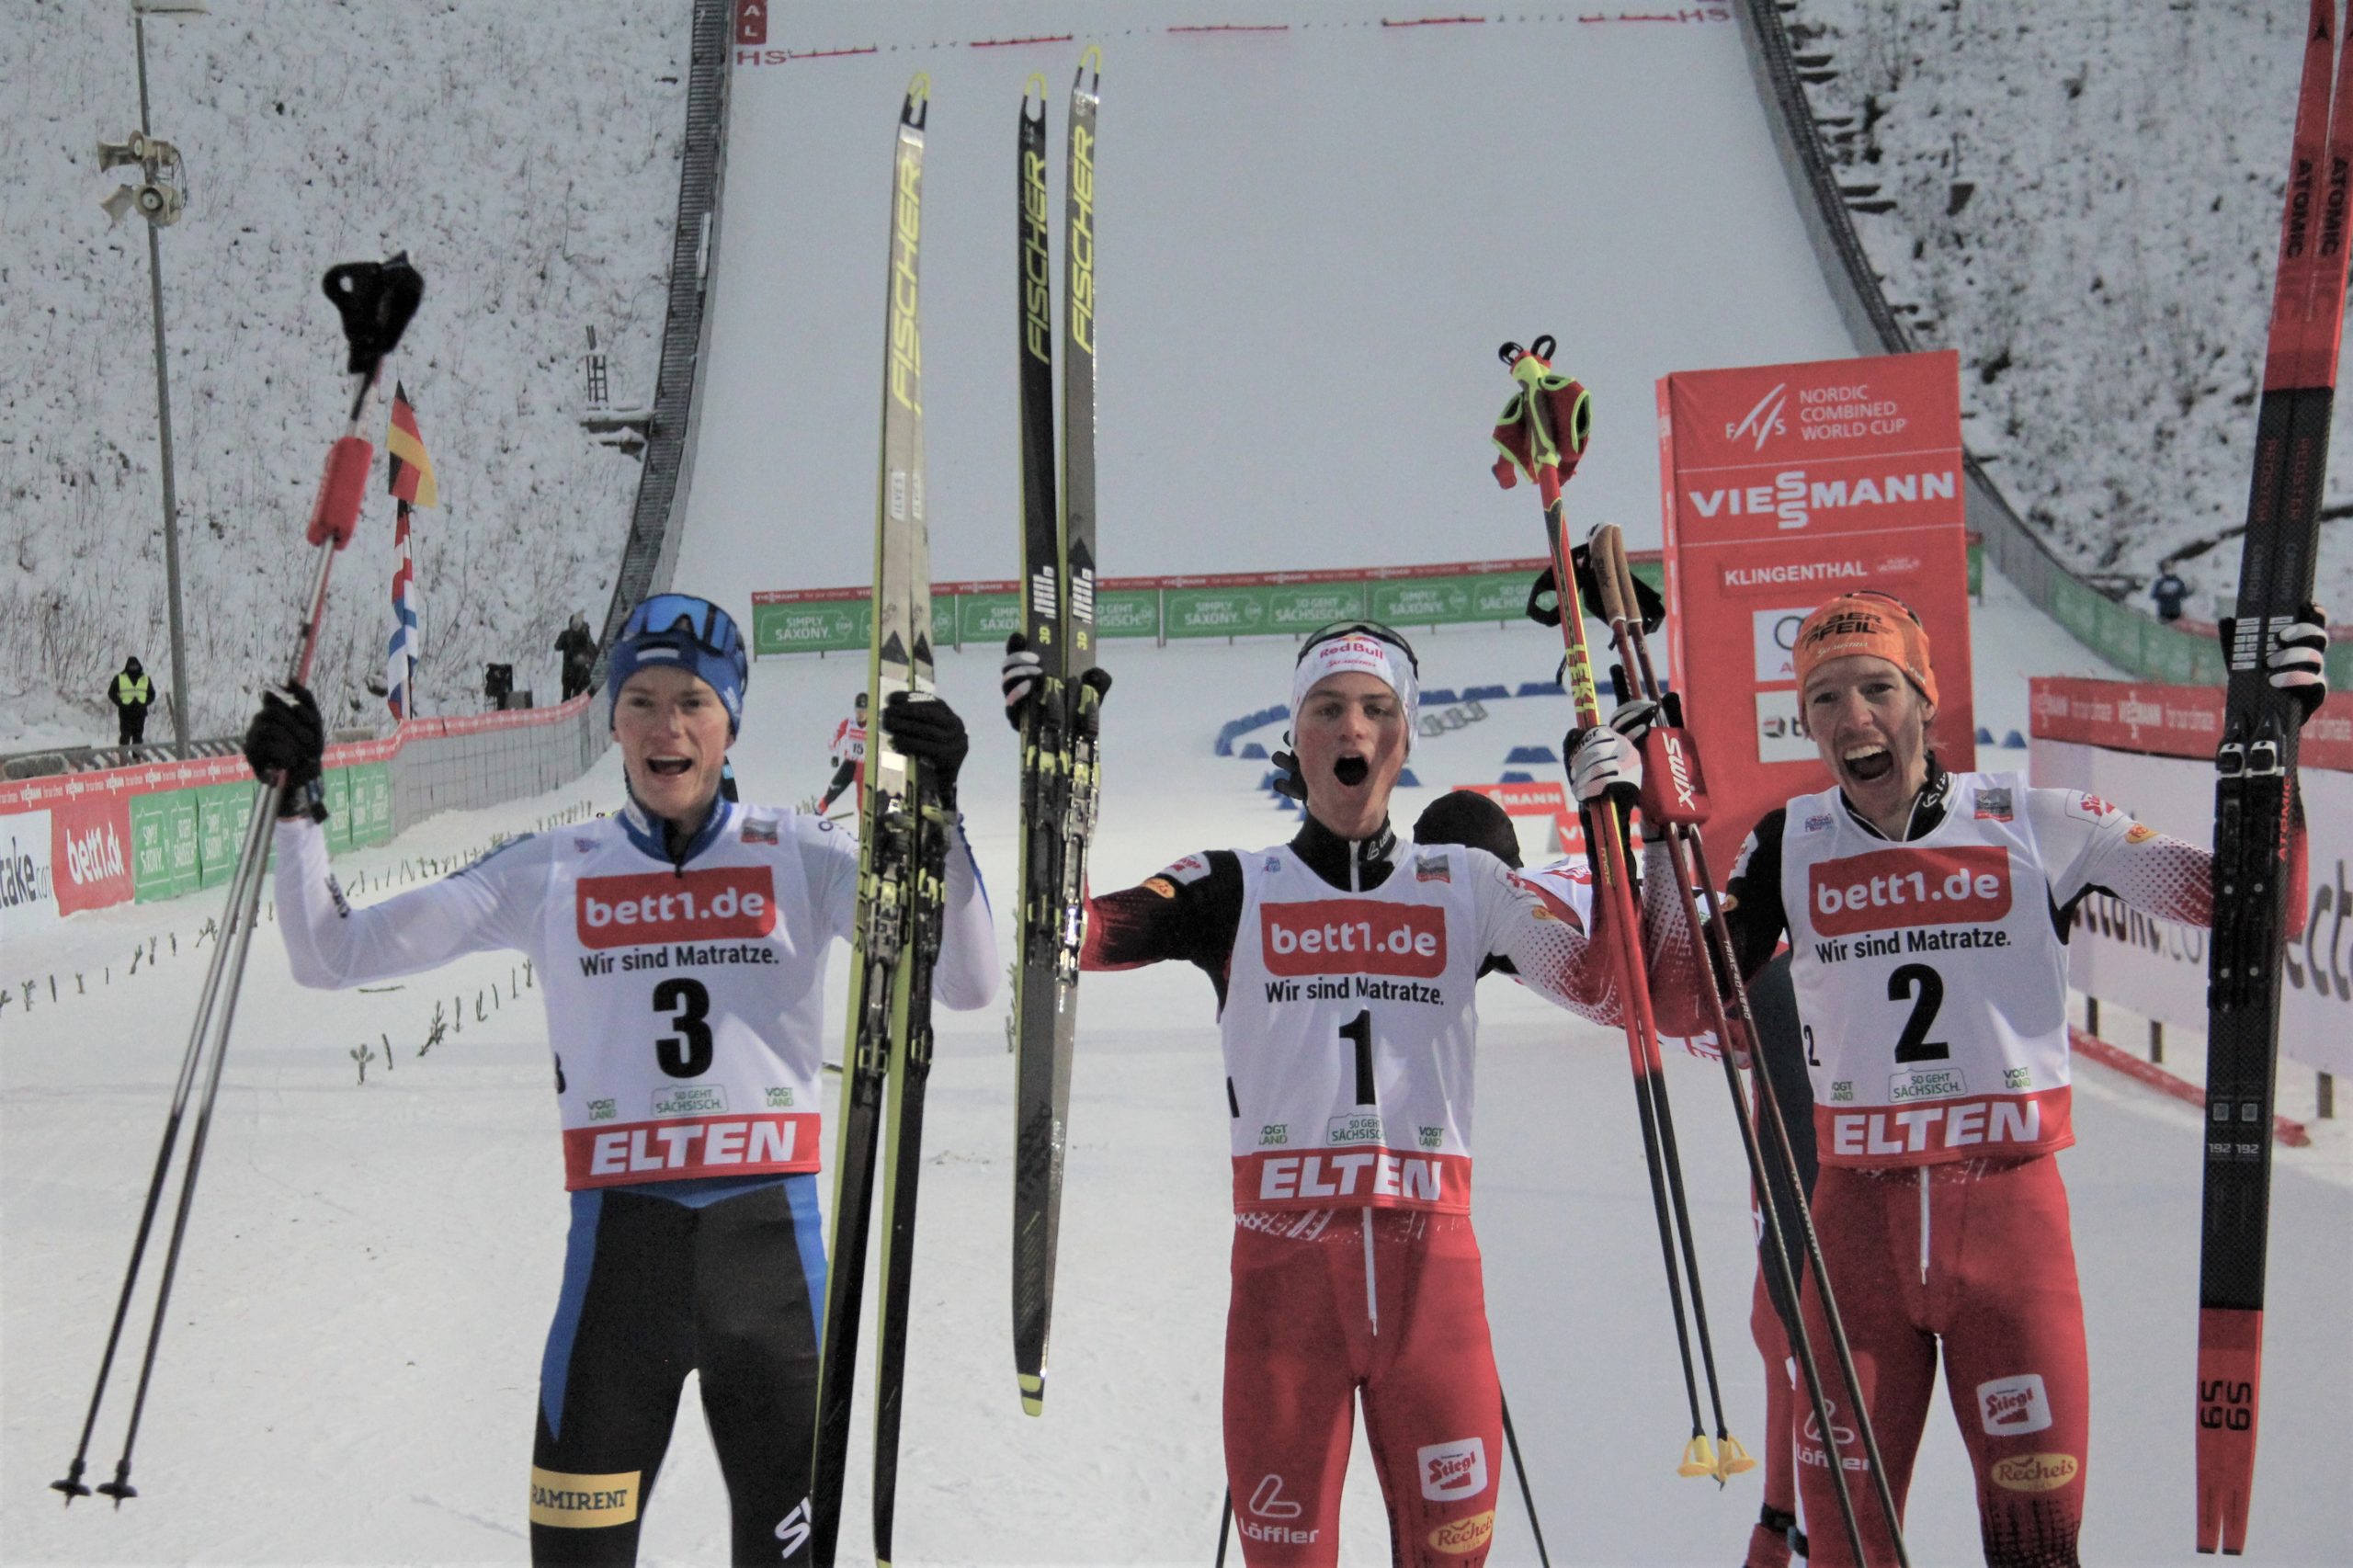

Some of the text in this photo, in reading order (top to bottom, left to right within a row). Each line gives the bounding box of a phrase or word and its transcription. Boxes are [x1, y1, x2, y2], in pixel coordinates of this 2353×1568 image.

[736, 50, 788, 66] HS
[2287, 157, 2313, 259] ATOMIC
[2320, 155, 2348, 257] ATOMIC
[1072, 125, 1095, 355] FISCHER
[1024, 151, 1050, 365] FISCHER
[892, 157, 921, 415] FISCHER
[1800, 385, 1868, 403] NORDIC
[1801, 402, 1896, 423] COMBINED
[1802, 418, 1906, 441] WORLD CUP
[1689, 471, 1955, 530] VIESSMANN
[1724, 561, 1868, 585] KLINGENTHAL
[1196, 601, 1233, 612] SIMPLY
[786, 615, 824, 627] SIMPLY
[1319, 642, 1383, 660] Red Bull
[2278, 778, 2291, 861] ATOMIC
[1817, 868, 1999, 915] bett1.de
[585, 886, 765, 927] bett1.de
[1271, 922, 1437, 957] bett1.de
[1815, 928, 2011, 963] Wir sind Matratze.
[580, 945, 779, 977] Wir sind Matratze.
[1265, 977, 1444, 1006] Wir sind Matratze.
[1888, 963, 1949, 1063] 2
[653, 978, 713, 1078] 3
[1339, 1009, 1376, 1106] 1
[1803, 1025, 1821, 1067] 2
[1911, 1073, 1950, 1085] SO GEHT
[2003, 1066, 2029, 1079] VOGT
[2006, 1077, 2030, 1089] LAND
[586, 1099, 616, 1110] VOGT
[675, 1089, 712, 1100] SO GEHT
[766, 1086, 793, 1097] VOGT
[767, 1096, 794, 1107] LAND
[589, 1109, 617, 1120] LAND
[1349, 1119, 1358, 1128] SO
[1834, 1100, 2040, 1155] ELTEN
[1419, 1126, 1443, 1137] VOGT
[1419, 1136, 1442, 1147] LAND
[590, 1120, 797, 1176] ELTEN
[2209, 1143, 2231, 1153] 192
[2235, 1143, 2259, 1154] 192
[1259, 1153, 1442, 1201] ELTEN
[1984, 1386, 2034, 1420] Stiegl
[1428, 1450, 1476, 1483] Stiegl
[1998, 1457, 2074, 1483] Recheis
[1240, 1517, 1319, 1544] Löffler
